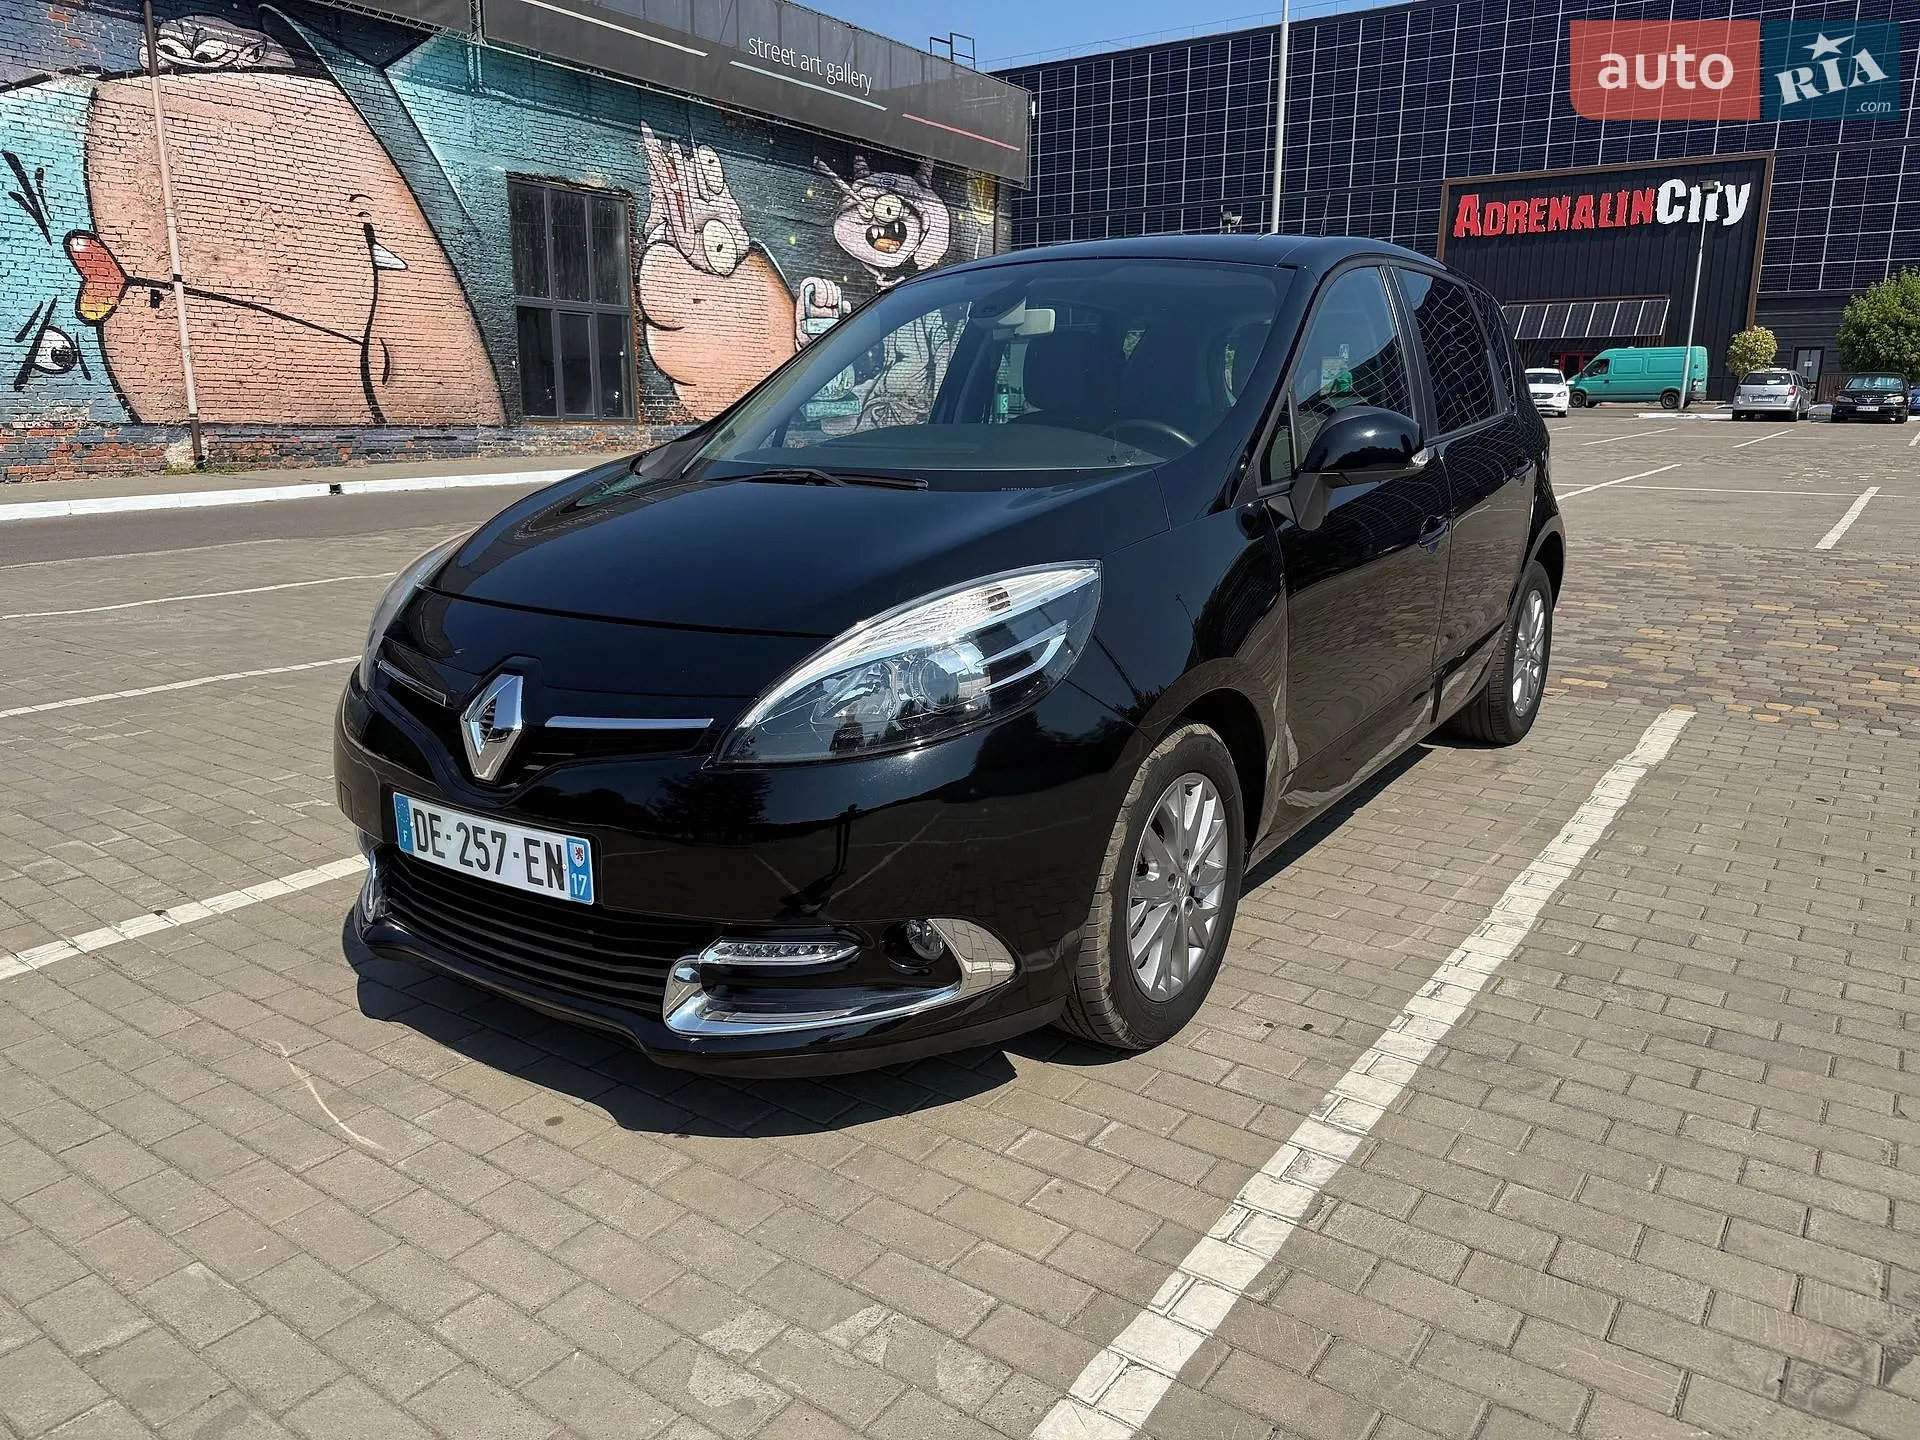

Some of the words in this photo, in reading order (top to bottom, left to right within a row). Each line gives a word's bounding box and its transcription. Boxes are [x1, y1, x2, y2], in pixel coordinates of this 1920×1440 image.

[748, 36, 797, 68] street
[800, 54, 824, 76] art
[826, 61, 873, 96] gallery
[402, 830, 408, 842] F
[412, 807, 566, 892] DE-257-EN
[571, 872, 588, 896] 17
